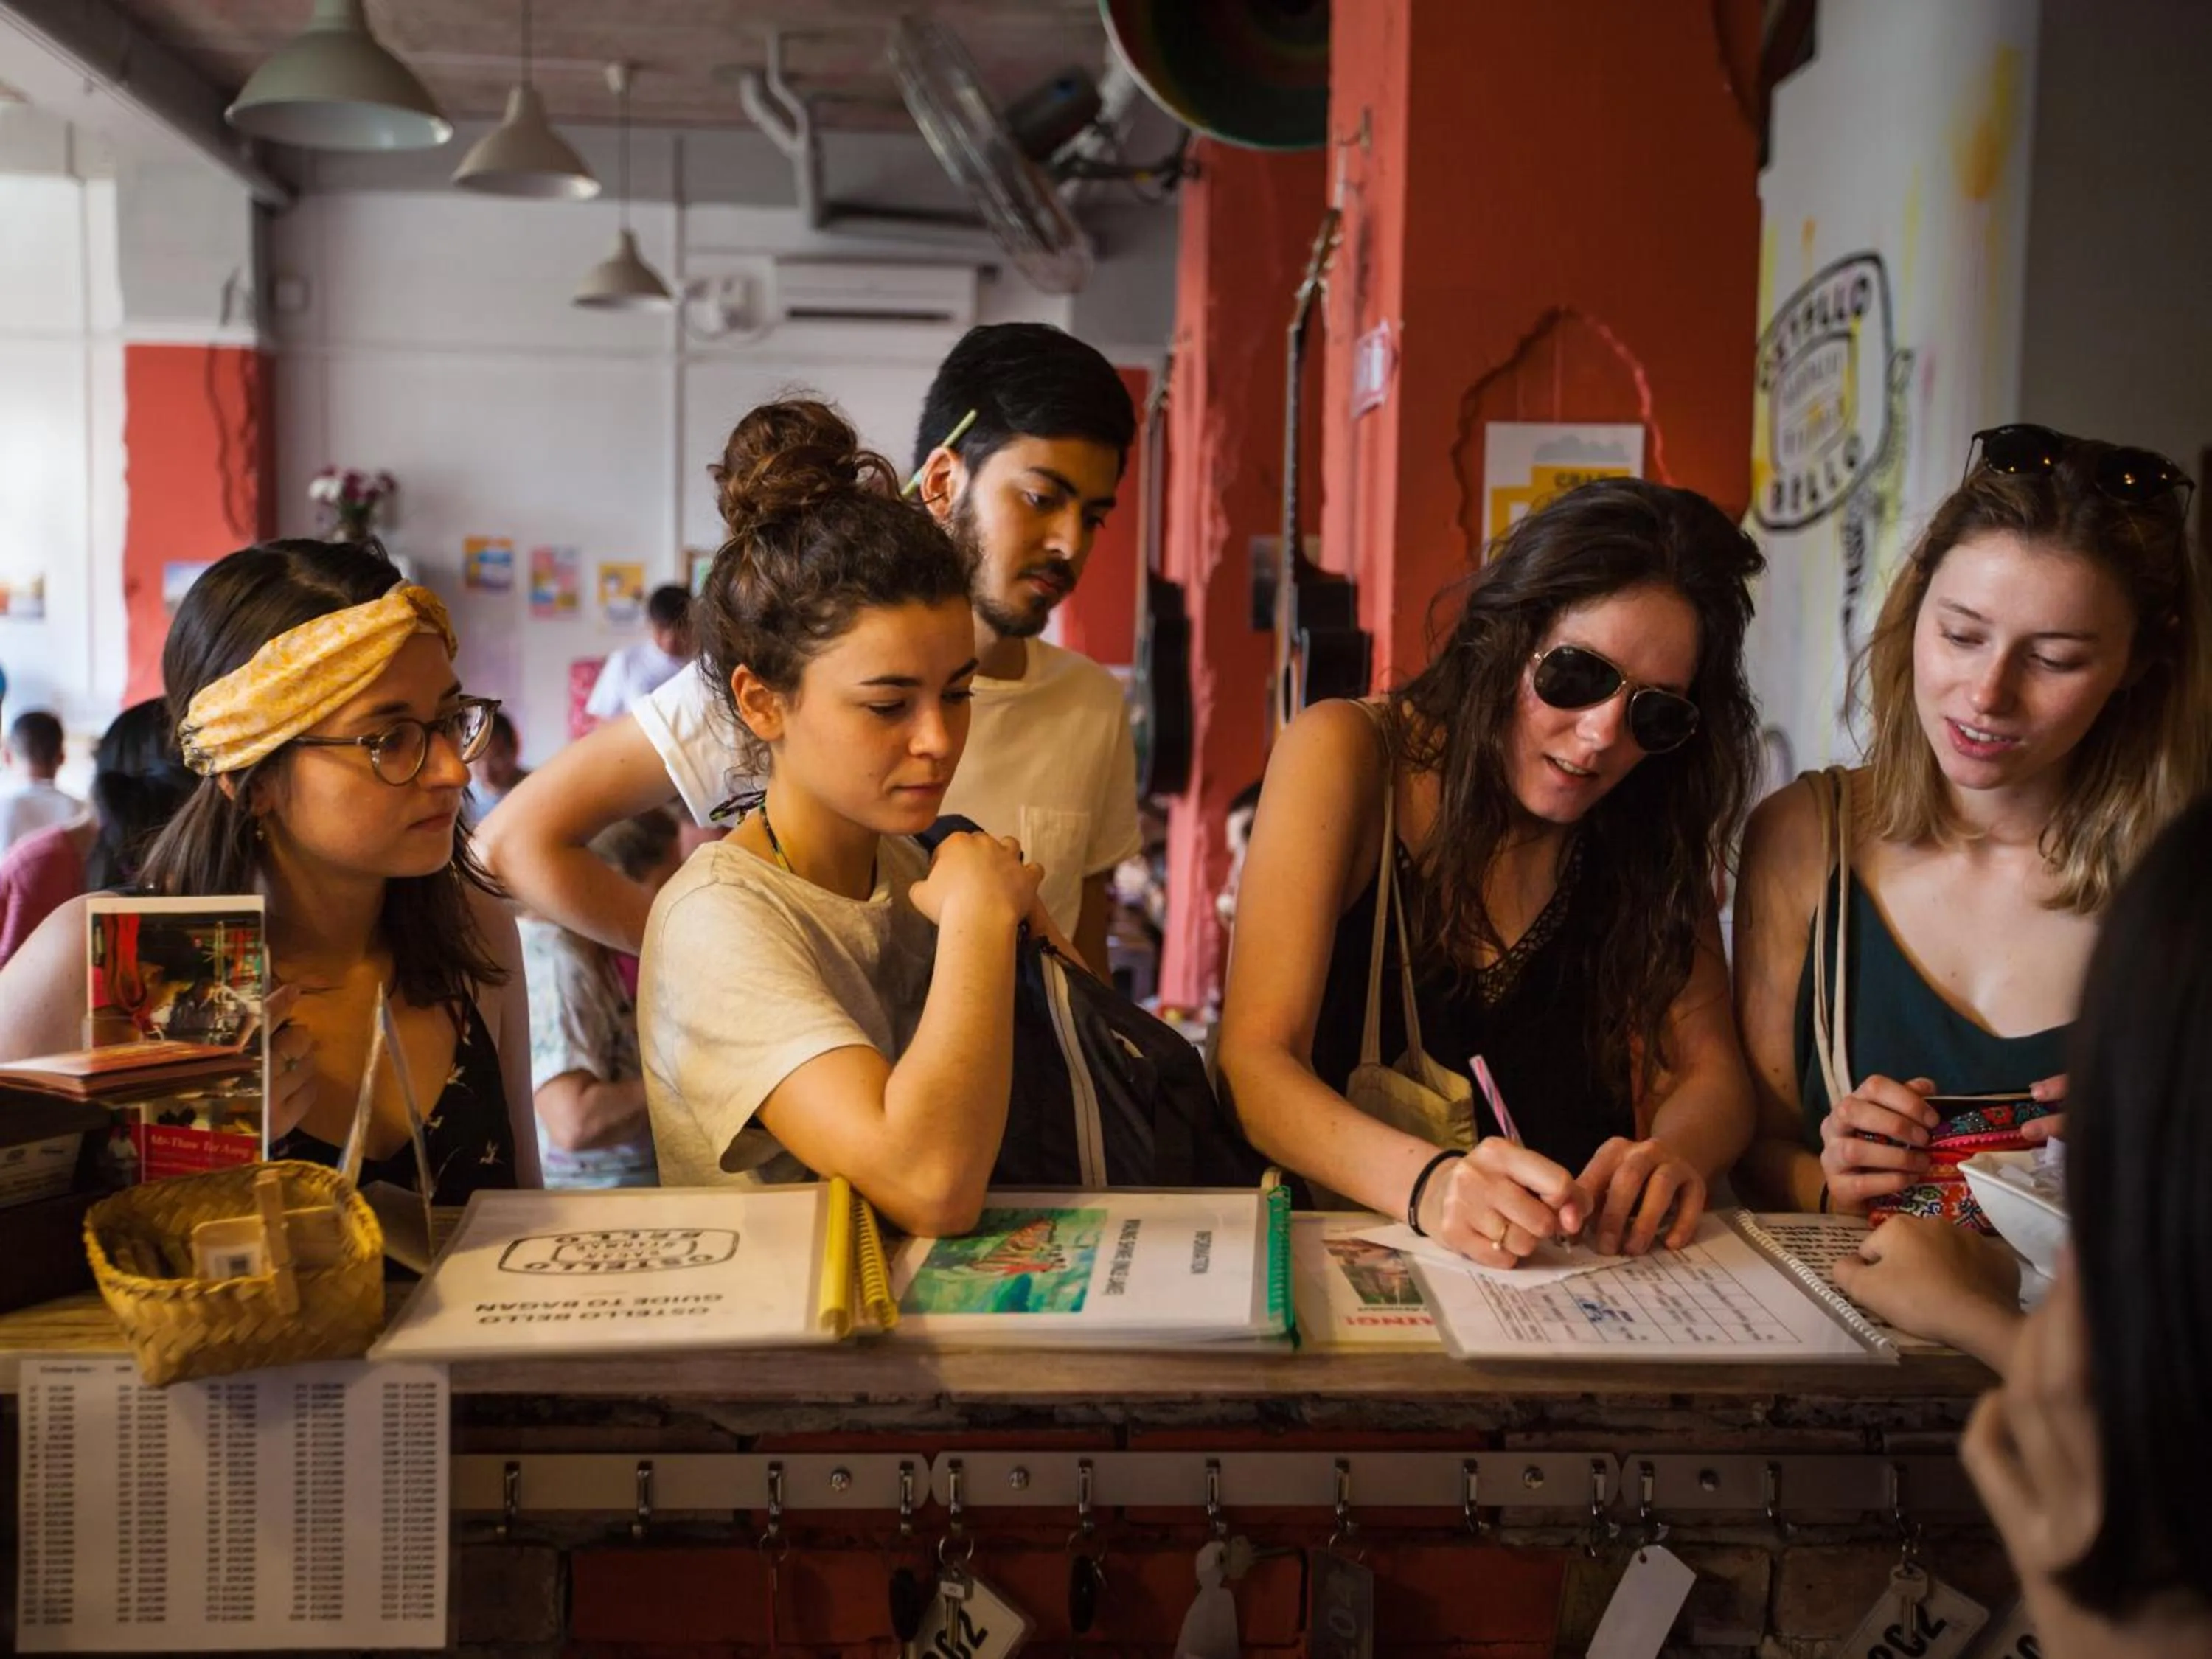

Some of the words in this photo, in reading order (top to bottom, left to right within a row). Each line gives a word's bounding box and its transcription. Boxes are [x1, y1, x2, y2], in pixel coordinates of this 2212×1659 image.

[524, 1254, 713, 1270] OSTELLO
[476, 1300, 580, 1312] BAGAN
[586, 1298, 622, 1307] TO
[633, 1294, 723, 1306] GUIDE
[479, 1314, 571, 1324] BELLO
[578, 1307, 709, 1320] OSTELLO
